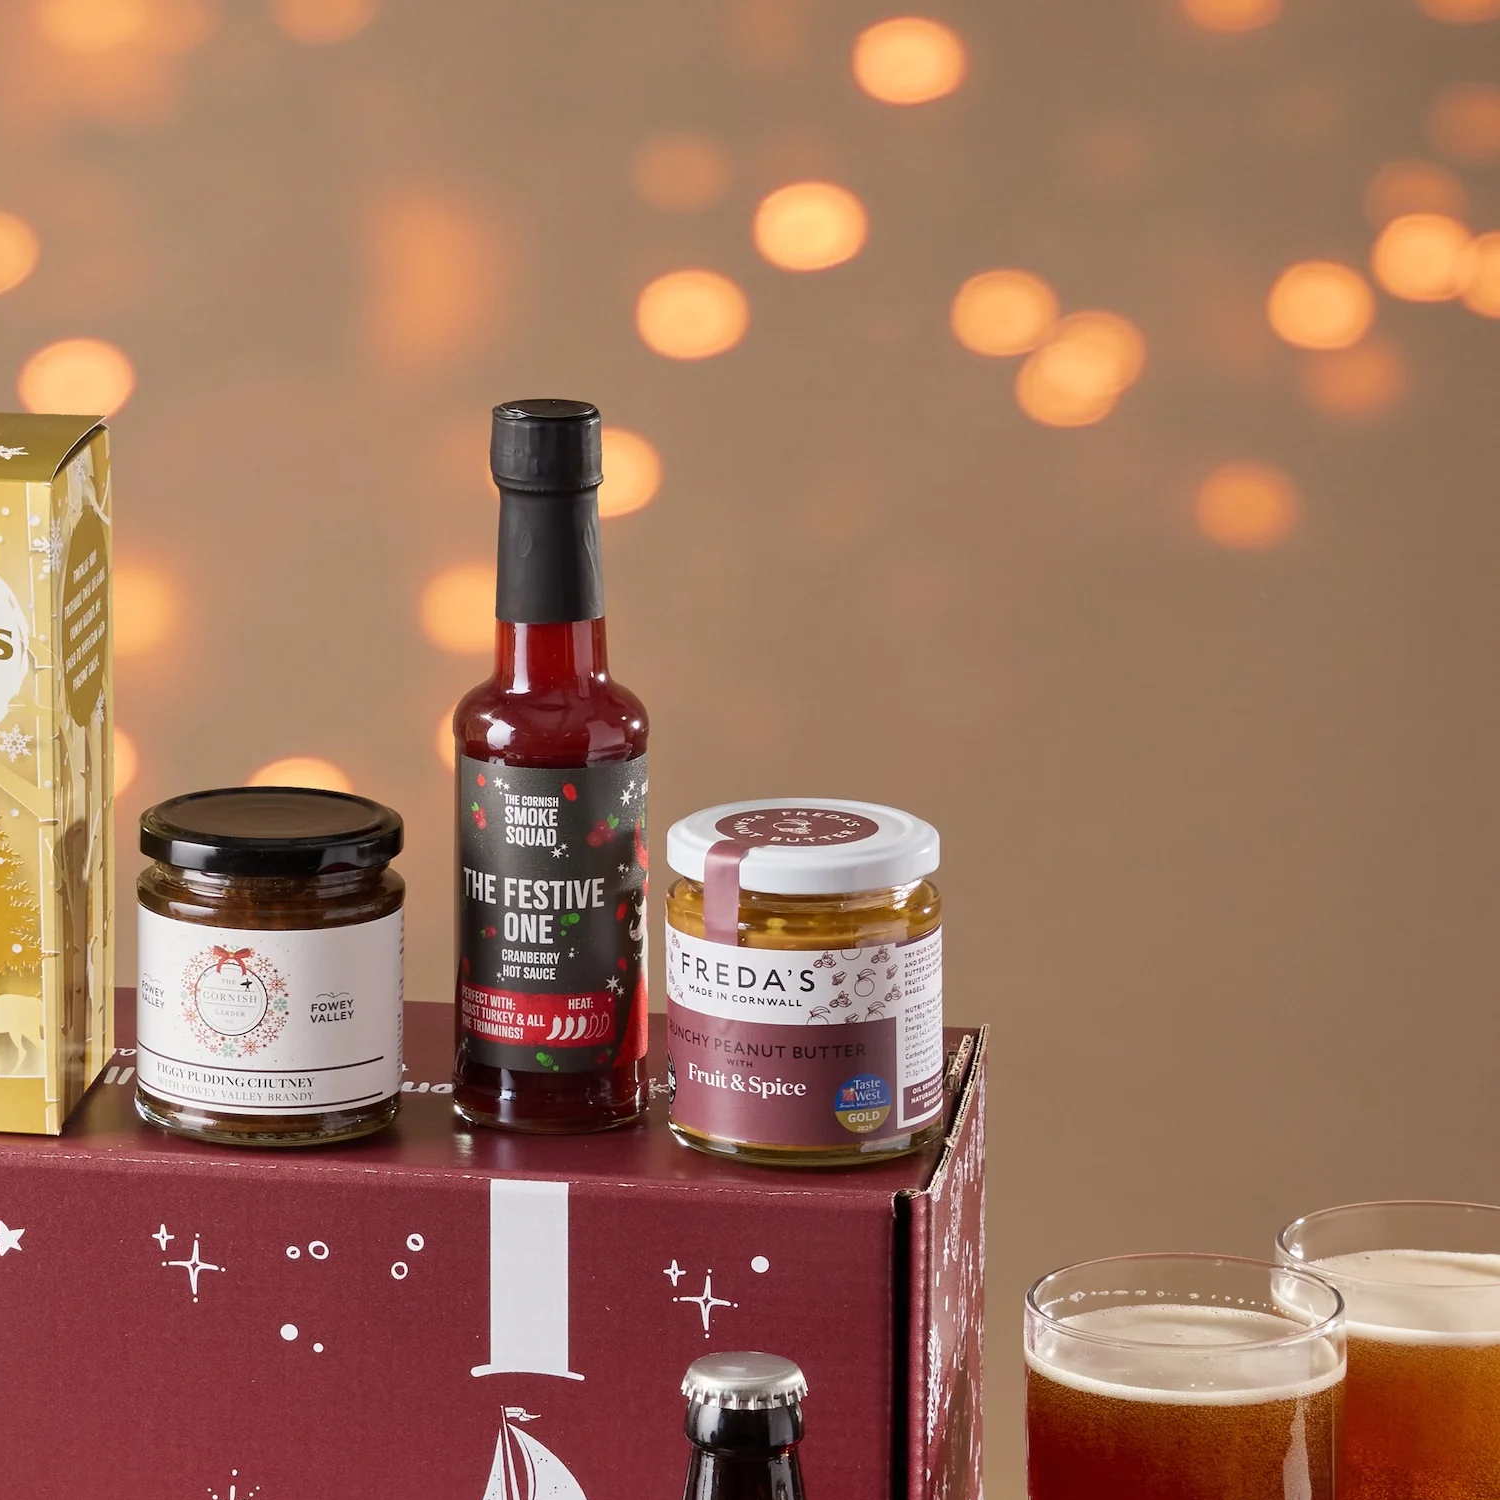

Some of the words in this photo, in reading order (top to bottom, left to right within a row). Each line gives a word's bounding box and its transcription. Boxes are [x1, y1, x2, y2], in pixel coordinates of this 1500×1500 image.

[504, 794, 519, 806] THE
[521, 795, 559, 808] CORNISH
[504, 805, 558, 827] SMOKE
[781, 811, 861, 828] FREDA'S
[505, 825, 557, 848] SQUAD
[463, 866, 497, 906] THE
[504, 877, 605, 911] FESTIVE
[504, 911, 554, 945] ONE
[502, 948, 560, 966] CRANBERRY
[502, 964, 521, 980] HOT
[523, 966, 556, 981] SAUCE
[681, 952, 816, 993] FREDA'S
[202, 990, 257, 1005] CORNISH
[490, 994, 516, 1011] WITH:
[568, 997, 594, 1010] HEAT:
[688, 983, 715, 999] MADE
[716, 989, 728, 1000] IN
[731, 993, 803, 1008] CORNWALL
[311, 999, 355, 1013] FOWEY
[310, 1009, 355, 1024] VALLEY
[481, 1006, 515, 1025] TURKEY
[516, 1013, 525, 1026] &
[526, 1013, 546, 1027] ALL
[473, 1018, 524, 1040] TRIMMINGS!
[714, 1037, 787, 1059] PEANUT
[791, 1042, 867, 1060] BUTTER
[726, 1058, 753, 1069] WITH
[157, 1061, 186, 1083] FIGGY
[188, 1068, 245, 1088] PUDDING
[247, 1077, 315, 1089] CHUTNEY
[688, 1062, 729, 1090] Fruit
[730, 1077, 746, 1092] &
[748, 1077, 808, 1100] Spice
[157, 1075, 180, 1092] WITH
[180, 1082, 218, 1099] FOWEY
[220, 1088, 264, 1102] VALLEY
[267, 1091, 314, 1102] BRANDY
[853, 1079, 881, 1090] Taste
[854, 1090, 881, 1102] West
[848, 1110, 880, 1123] GOLD
